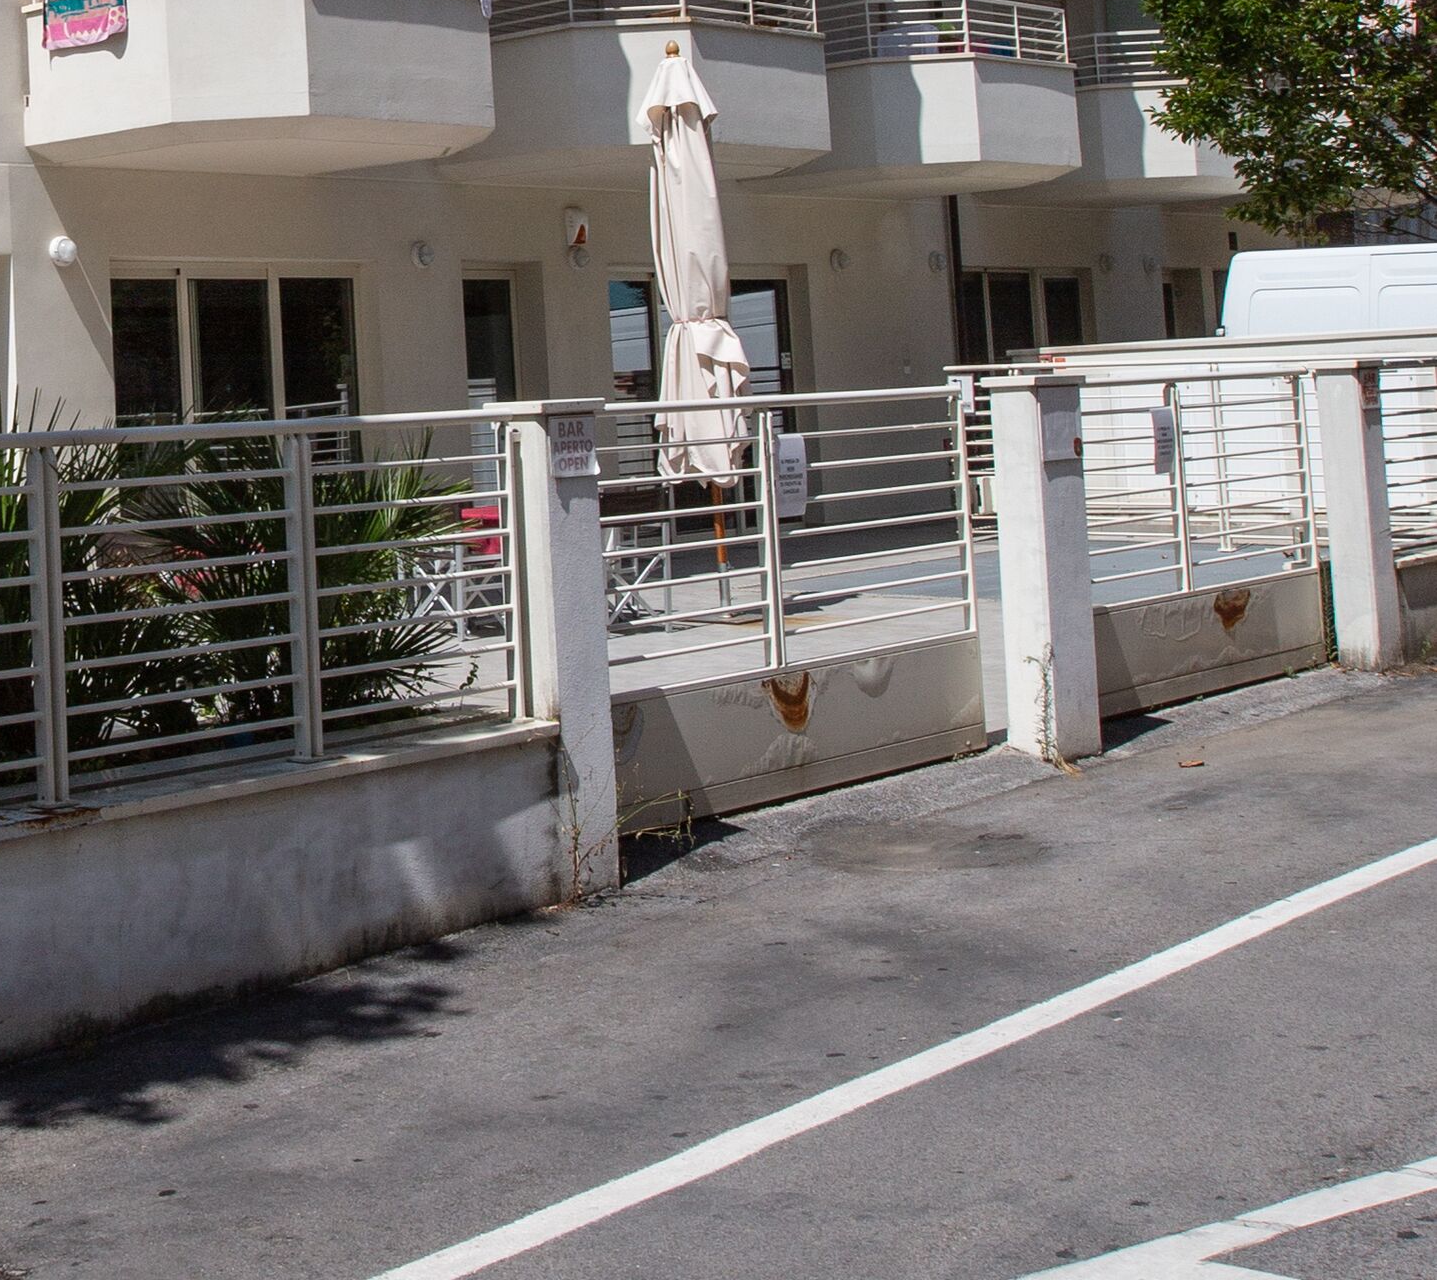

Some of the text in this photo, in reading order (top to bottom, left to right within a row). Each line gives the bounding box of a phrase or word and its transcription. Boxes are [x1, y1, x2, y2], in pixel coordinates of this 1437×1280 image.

[558, 421, 584, 438] BAR
[553, 439, 593, 455] APERTO
[559, 456, 590, 471] OPEN
